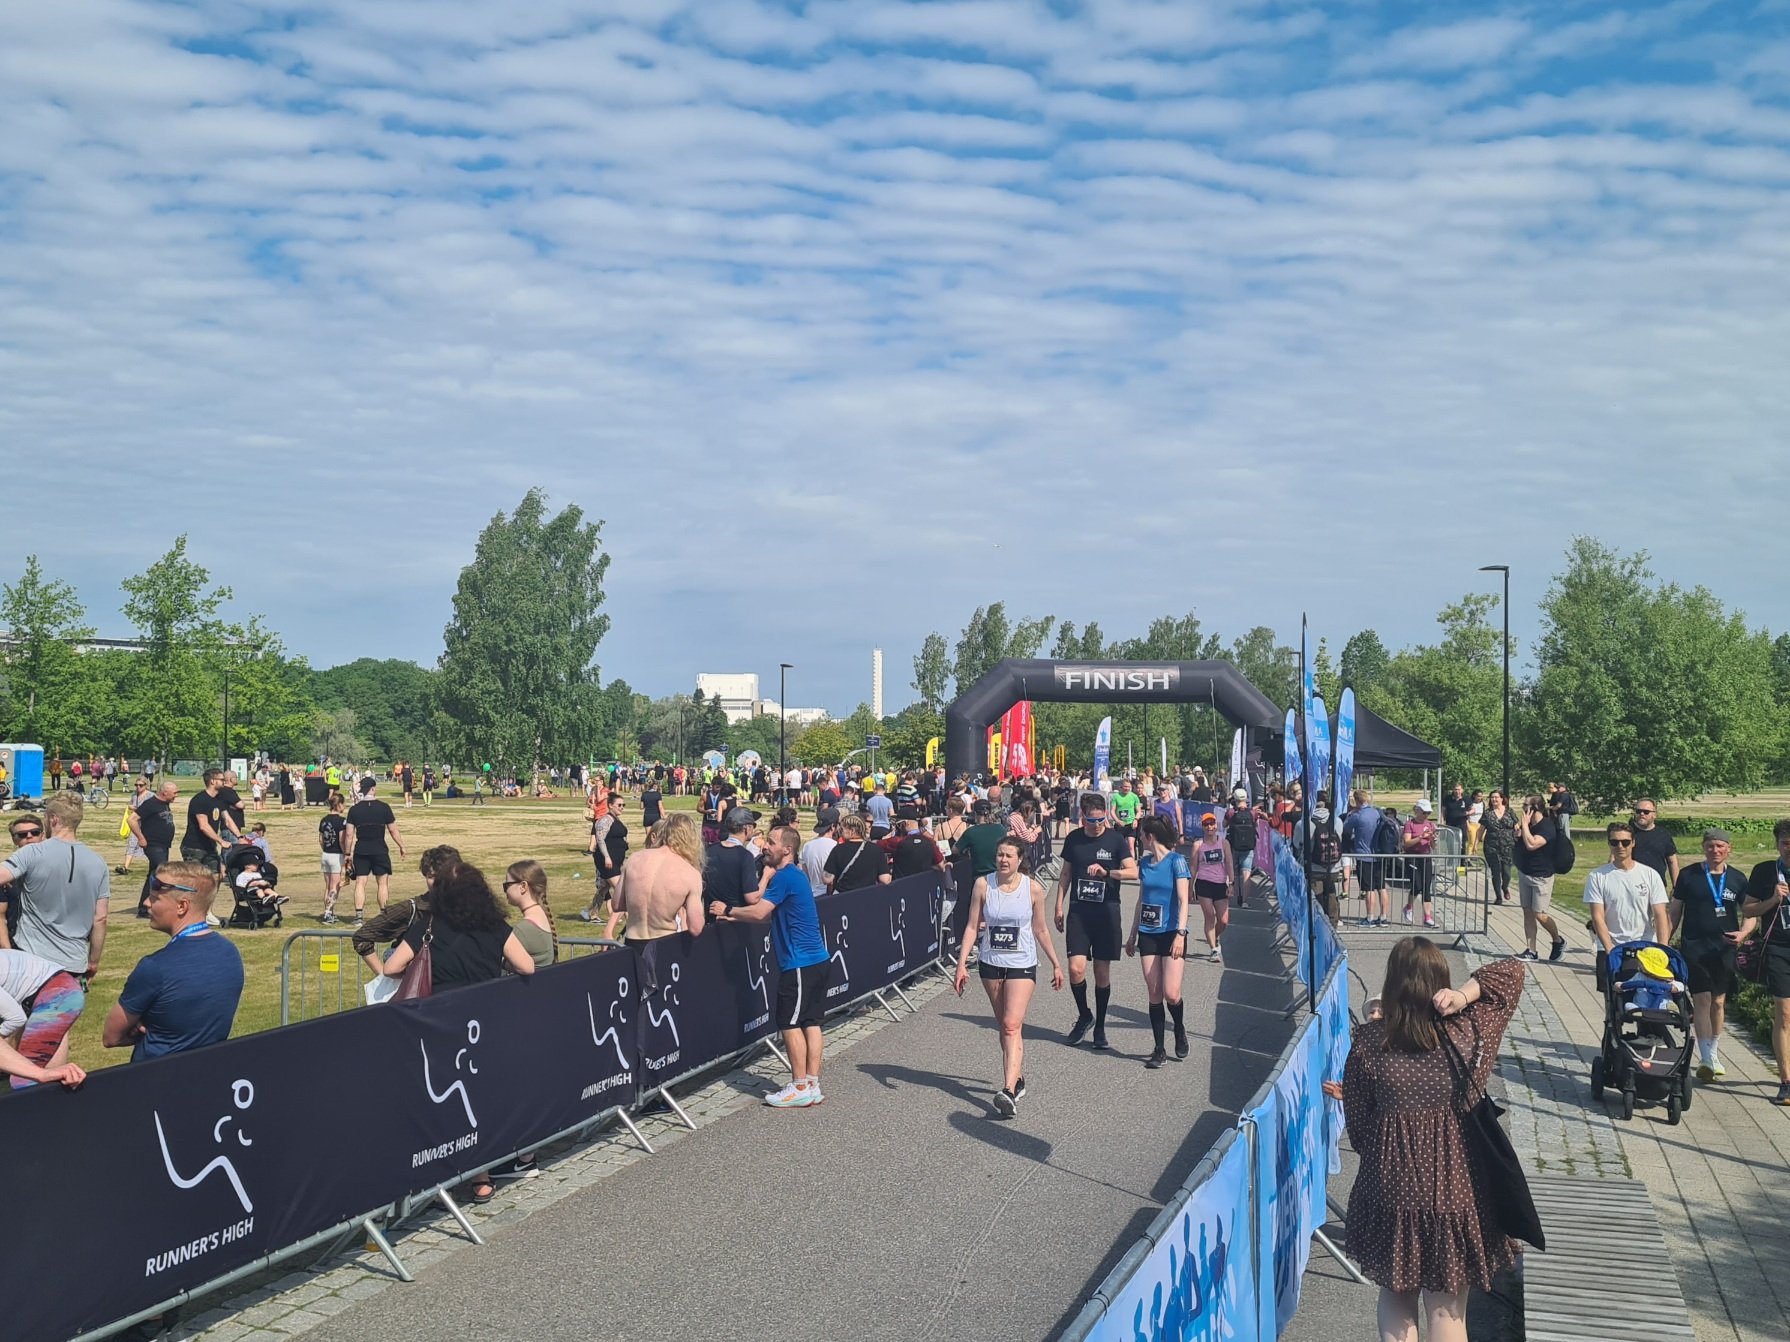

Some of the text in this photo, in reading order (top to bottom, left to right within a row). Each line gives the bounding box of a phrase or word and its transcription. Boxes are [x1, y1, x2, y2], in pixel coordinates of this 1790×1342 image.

[1065, 671, 1170, 690] FINISH
[994, 933, 1014, 942] 3273
[666, 1049, 680, 1066] HIGH
[609, 1072, 632, 1088] HIGH
[411, 1131, 479, 1169] RUNNER'S HIGH
[145, 1216, 254, 1277] RUNNER'S HIGH
